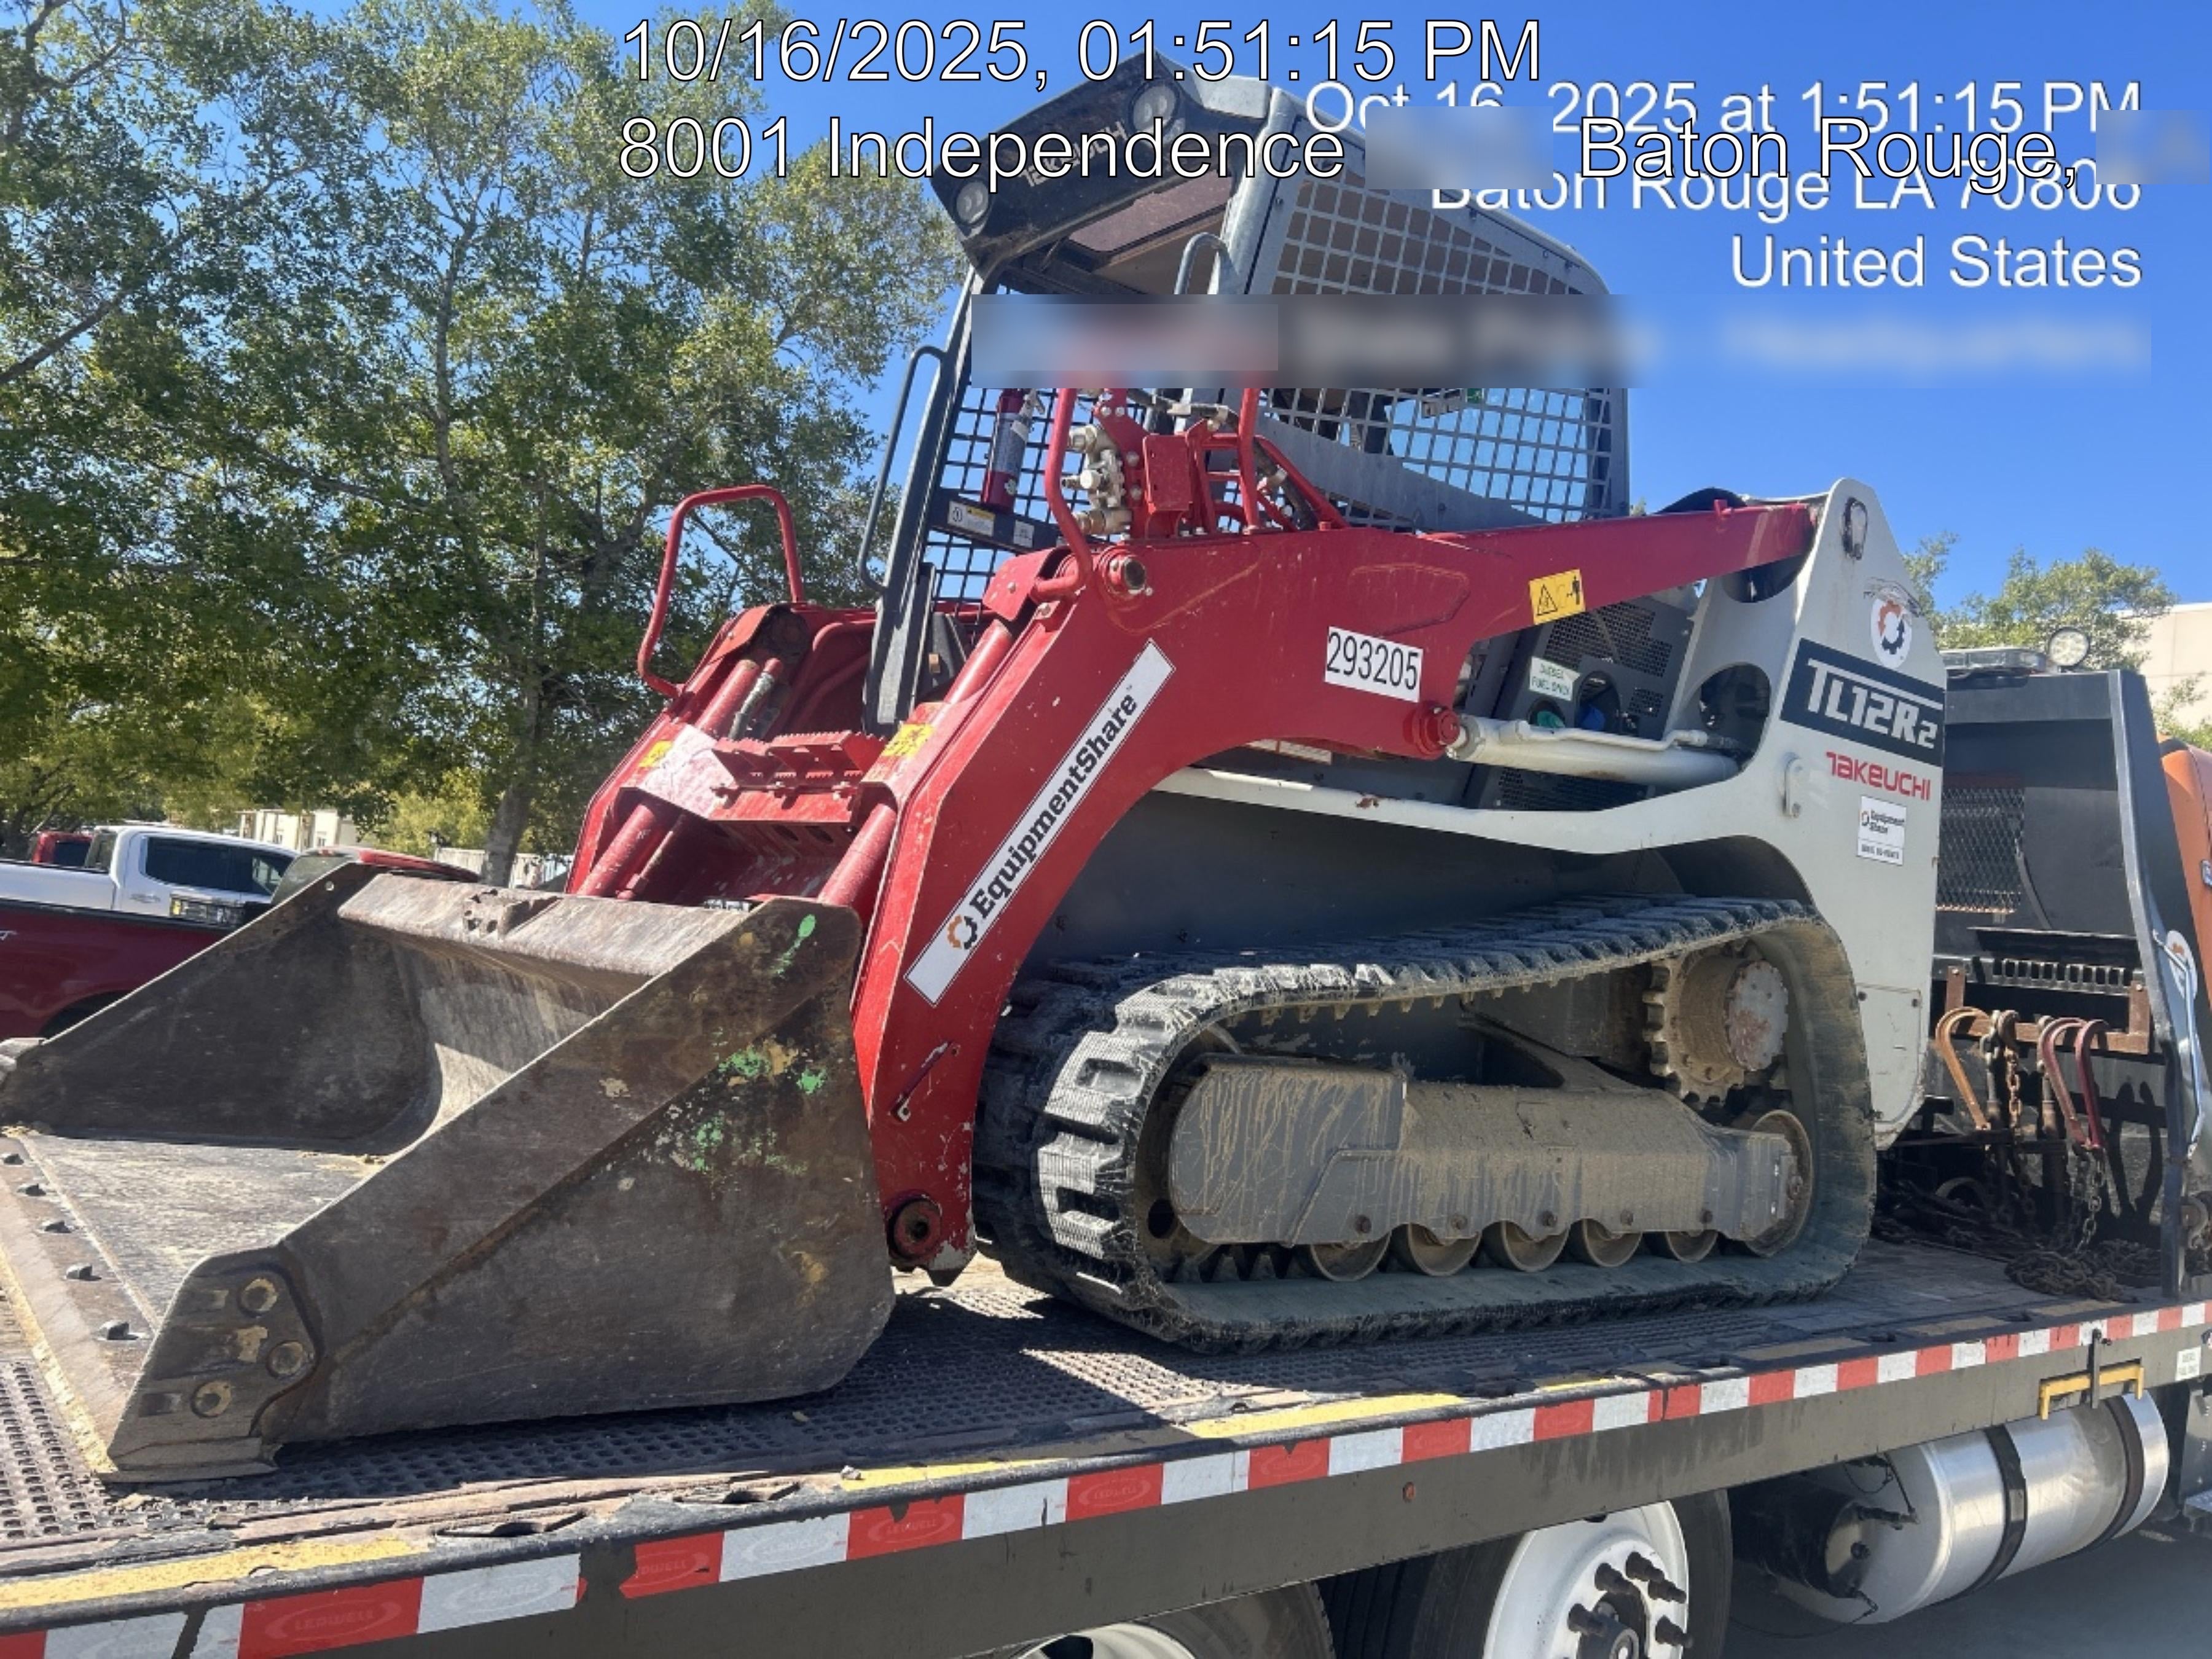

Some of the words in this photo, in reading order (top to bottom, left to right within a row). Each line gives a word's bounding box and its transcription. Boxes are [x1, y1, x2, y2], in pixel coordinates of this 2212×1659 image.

[1326, 629, 1420, 691] 293205
[1807, 657, 1943, 750] TL12R2
[968, 692, 1139, 920] EquipmentShare
